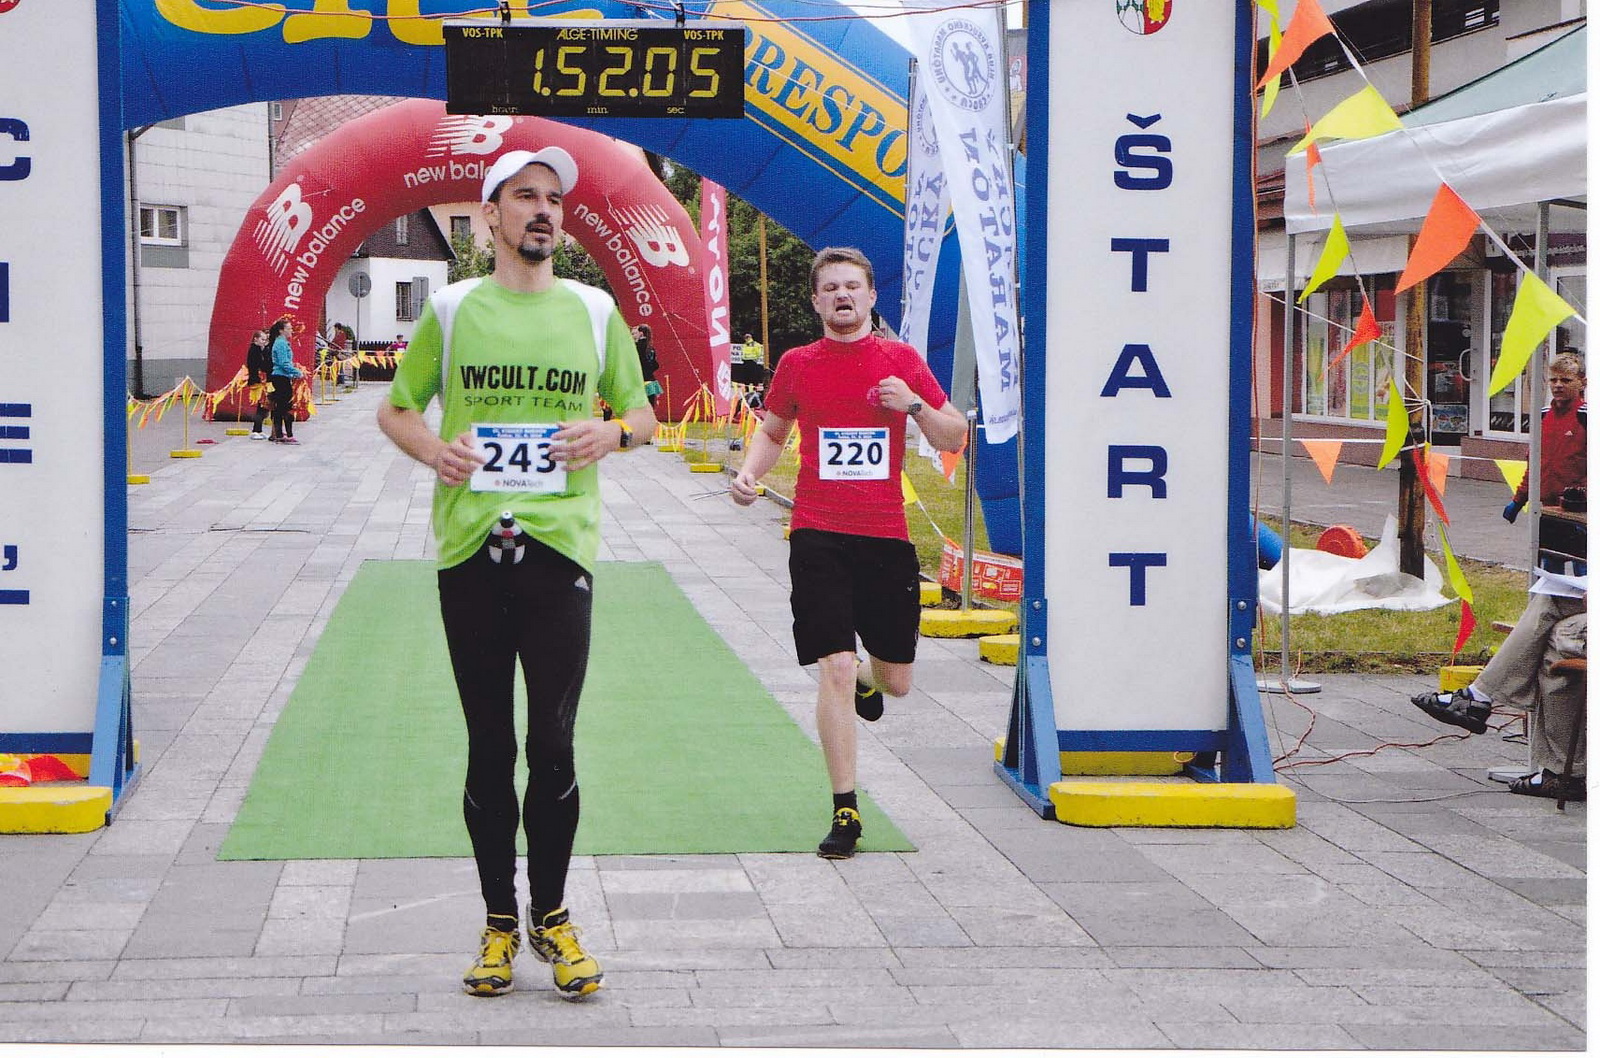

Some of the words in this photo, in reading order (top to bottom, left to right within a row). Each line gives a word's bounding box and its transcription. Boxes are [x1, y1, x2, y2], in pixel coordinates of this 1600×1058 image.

[462, 28, 504, 38] VOS-TPK
[556, 29, 638, 41] ALGE-TIMING
[684, 30, 724, 41] VOS-TPK
[403, 164, 446, 189] new
[284, 265, 304, 309] new
[301, 197, 367, 269] balance
[573, 203, 612, 238] new
[606, 230, 653, 317] balance
[1100, 113, 1173, 606] ŠTART
[460, 364, 588, 396] VWCULT.COM
[464, 395, 525, 408] SPORT
[531, 396, 583, 412] TEAM
[482, 441, 557, 474] 243
[827, 441, 883, 466] 220
